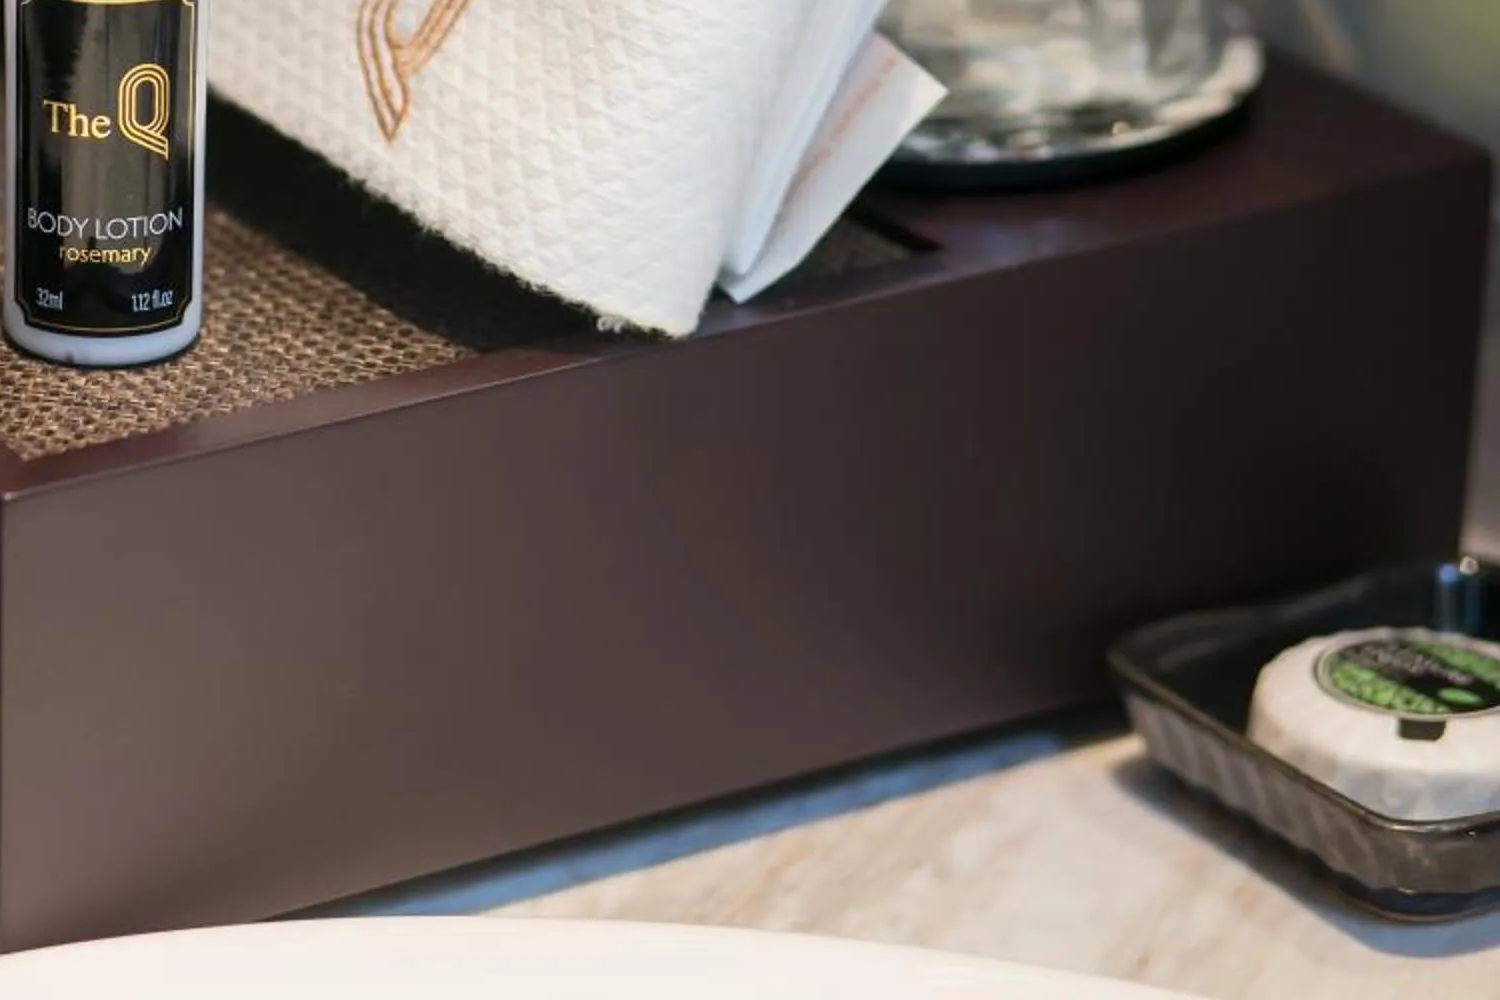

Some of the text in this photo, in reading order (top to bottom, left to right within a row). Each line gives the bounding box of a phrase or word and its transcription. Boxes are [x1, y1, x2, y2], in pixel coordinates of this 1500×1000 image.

[43, 63, 170, 160] The Q
[27, 207, 183, 240] BODY LOTION
[59, 246, 152, 268] rosemary
[36, 287, 64, 311] 32ml
